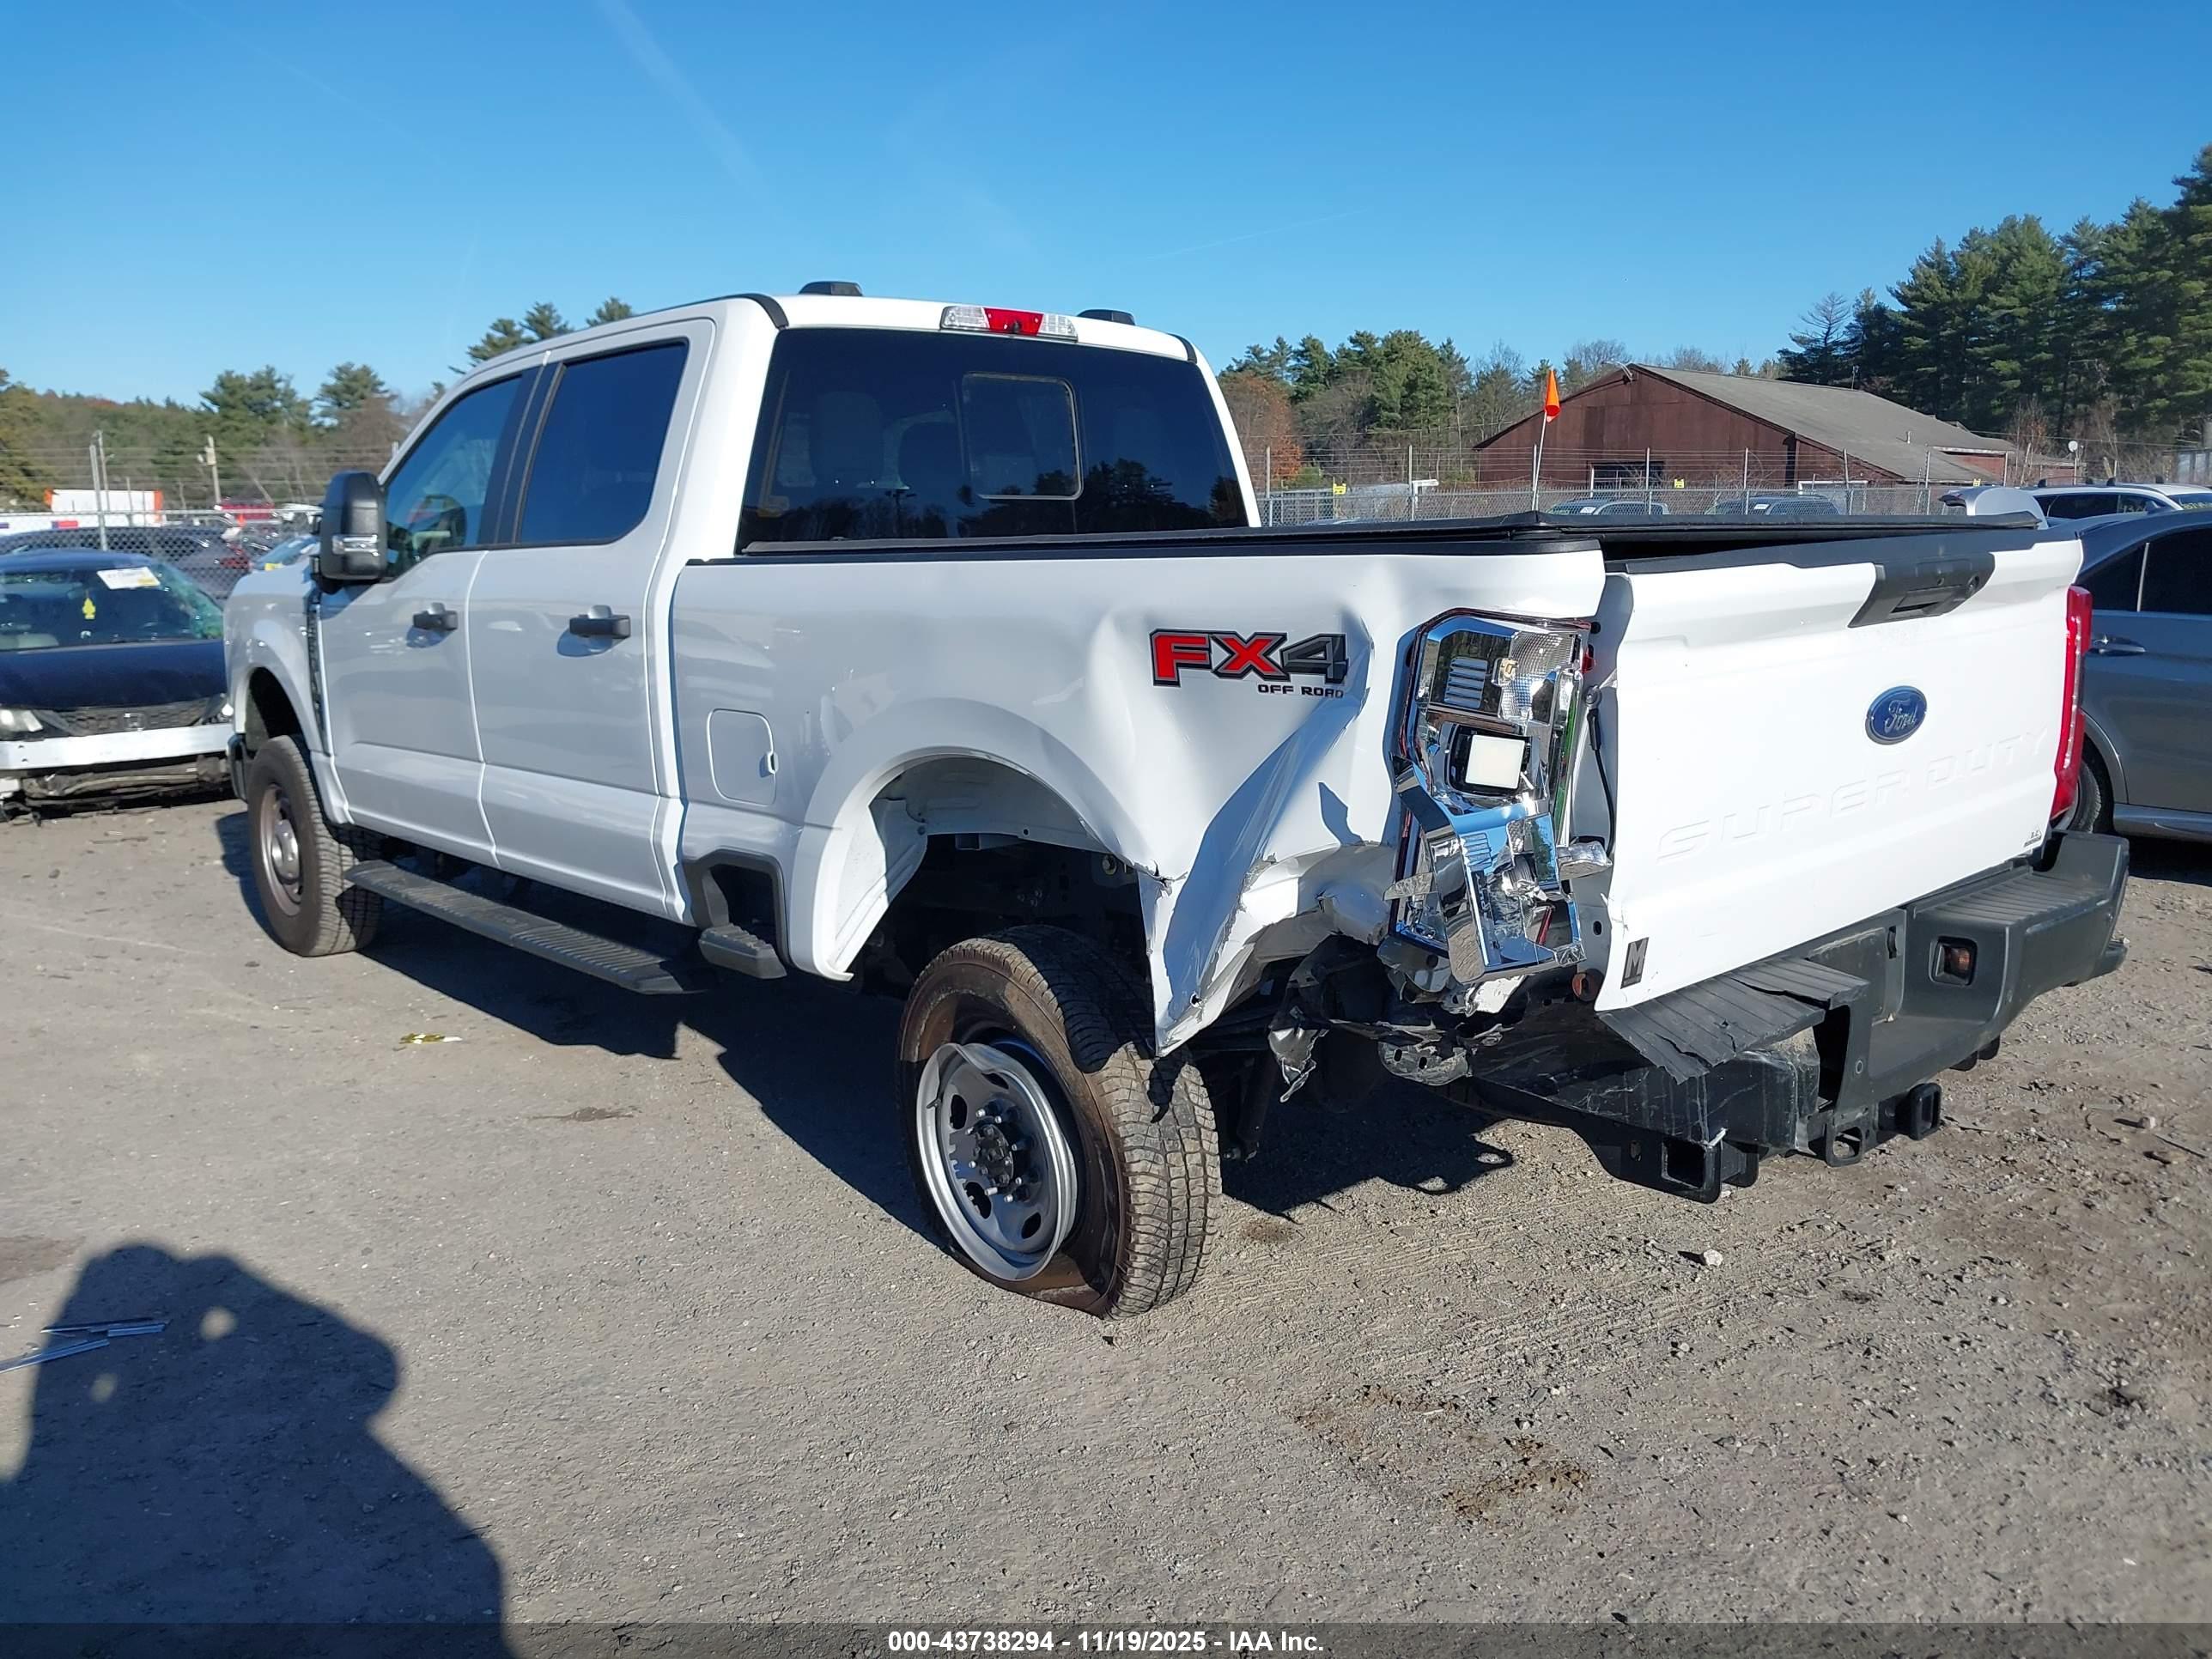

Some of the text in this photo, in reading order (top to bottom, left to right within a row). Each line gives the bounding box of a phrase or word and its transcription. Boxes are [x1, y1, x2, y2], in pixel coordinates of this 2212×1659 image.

[1149, 629, 1349, 687] FX4
[1258, 684, 1344, 699] OFF ROAD
[1884, 698, 1918, 734] Ford
[1656, 724, 2048, 861] SUPER DUTY
